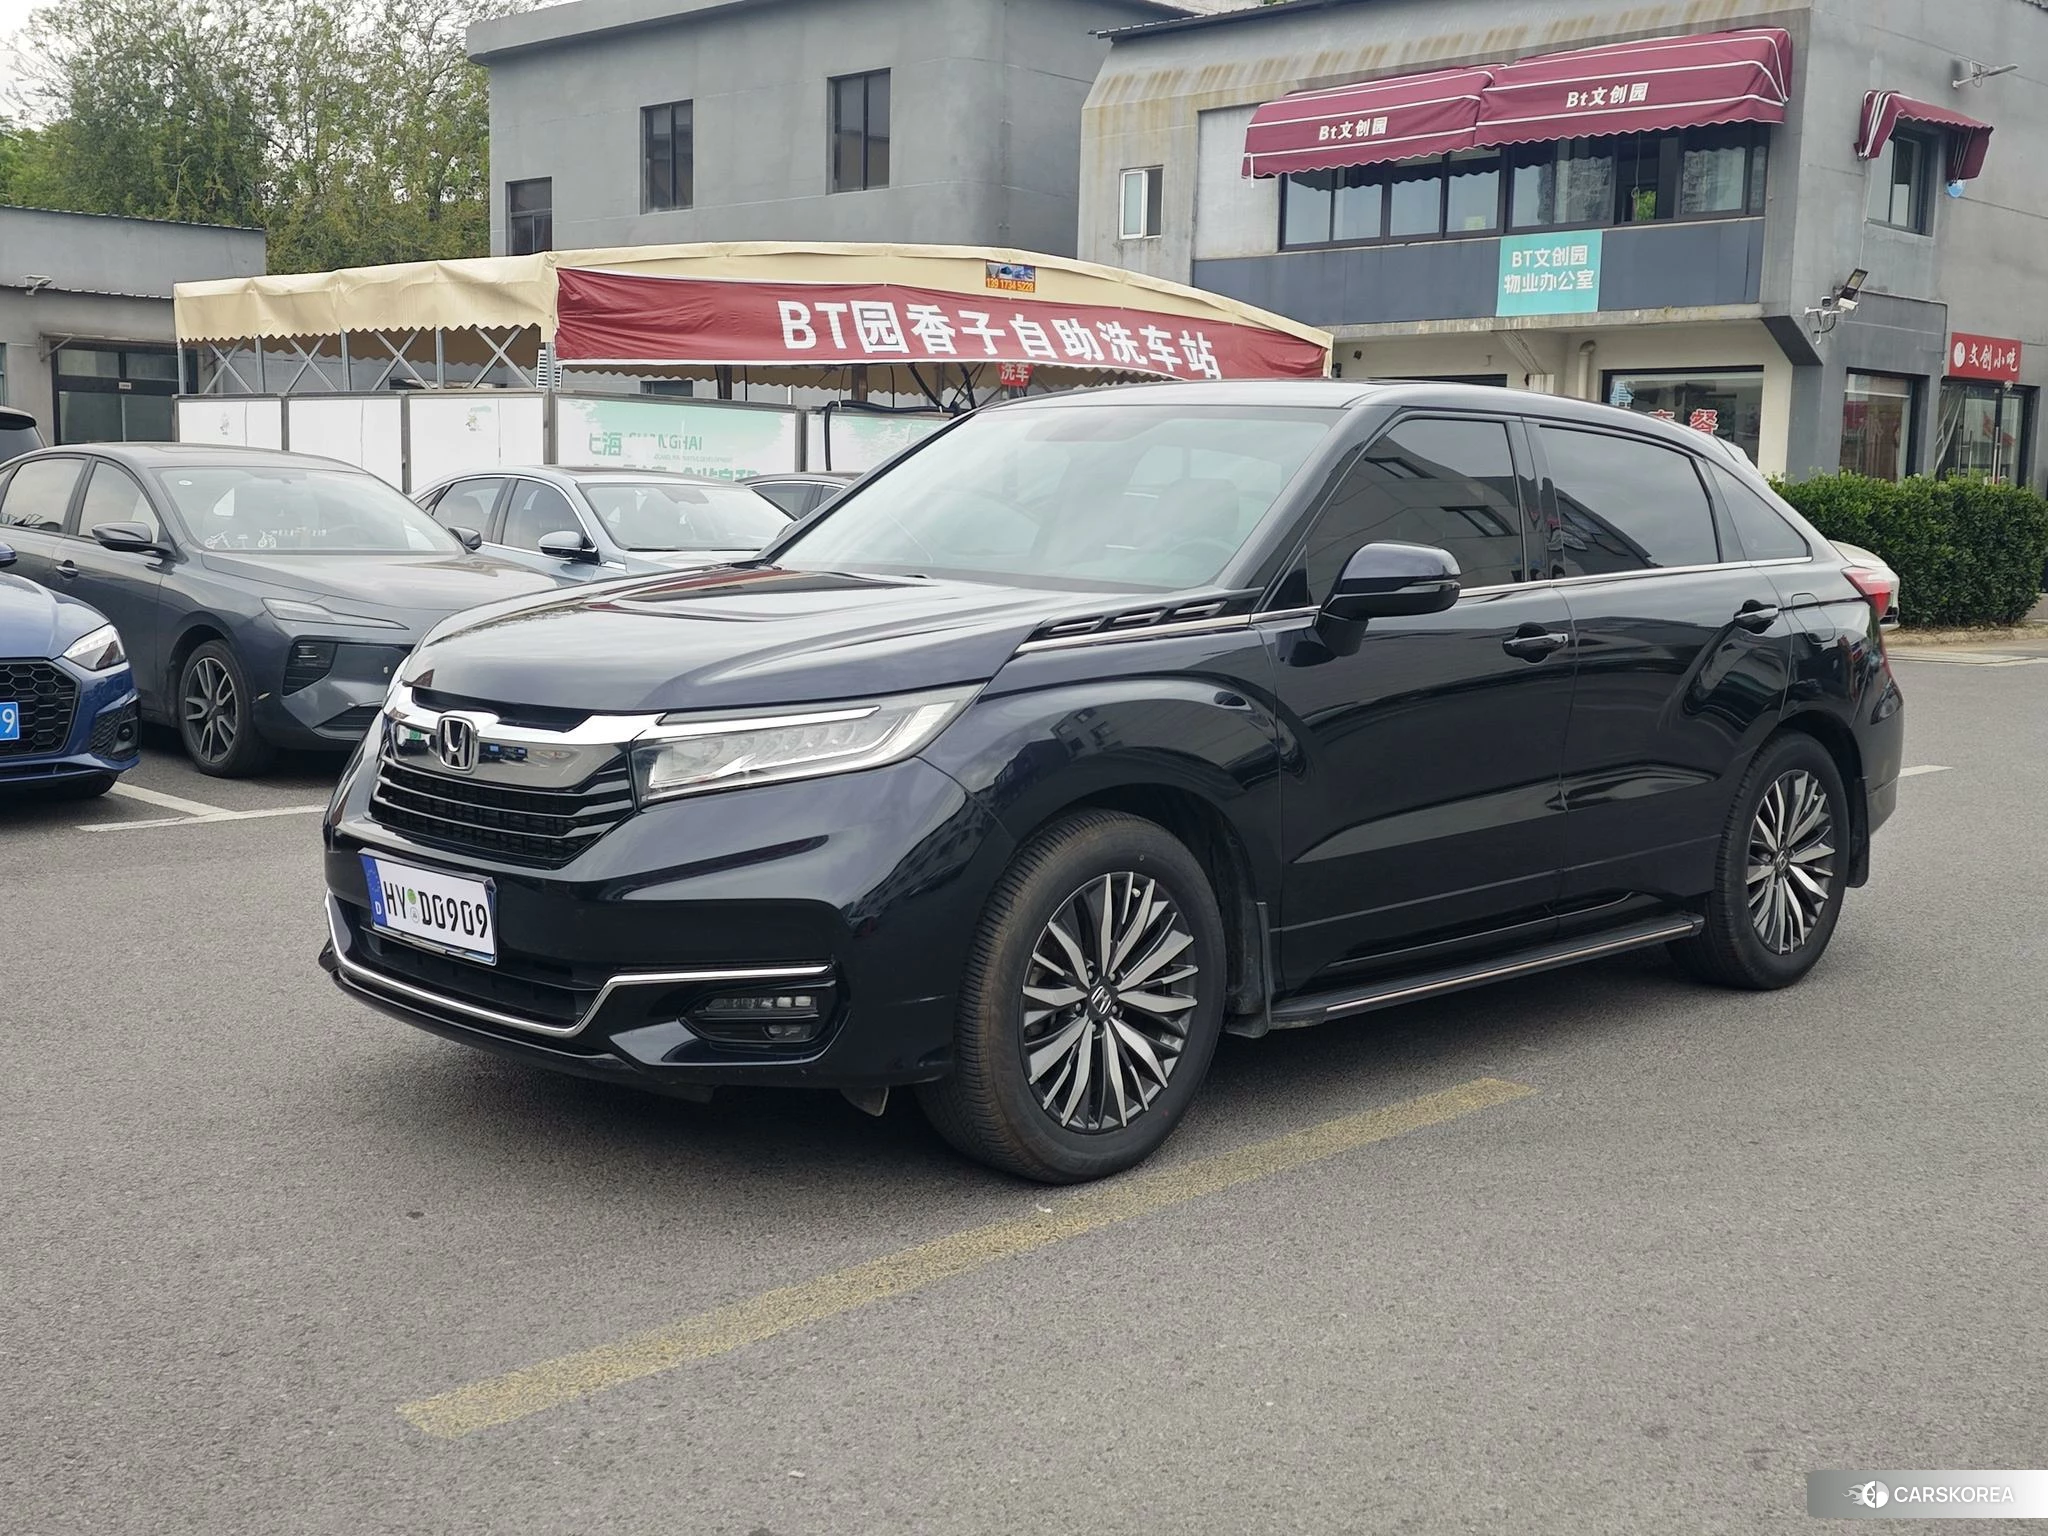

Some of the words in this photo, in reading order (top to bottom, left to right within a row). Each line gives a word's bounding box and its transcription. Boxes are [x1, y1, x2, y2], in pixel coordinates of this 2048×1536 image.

[1566, 82, 1649, 108] Bt文创园
[1319, 116, 1388, 140] Bt文创园
[1511, 245, 1588, 268] BT文创园
[1503, 269, 1594, 294] 物业办公室
[777, 300, 1222, 380] BT园香子自助洗车站
[1001, 362, 1029, 382] 洗车
